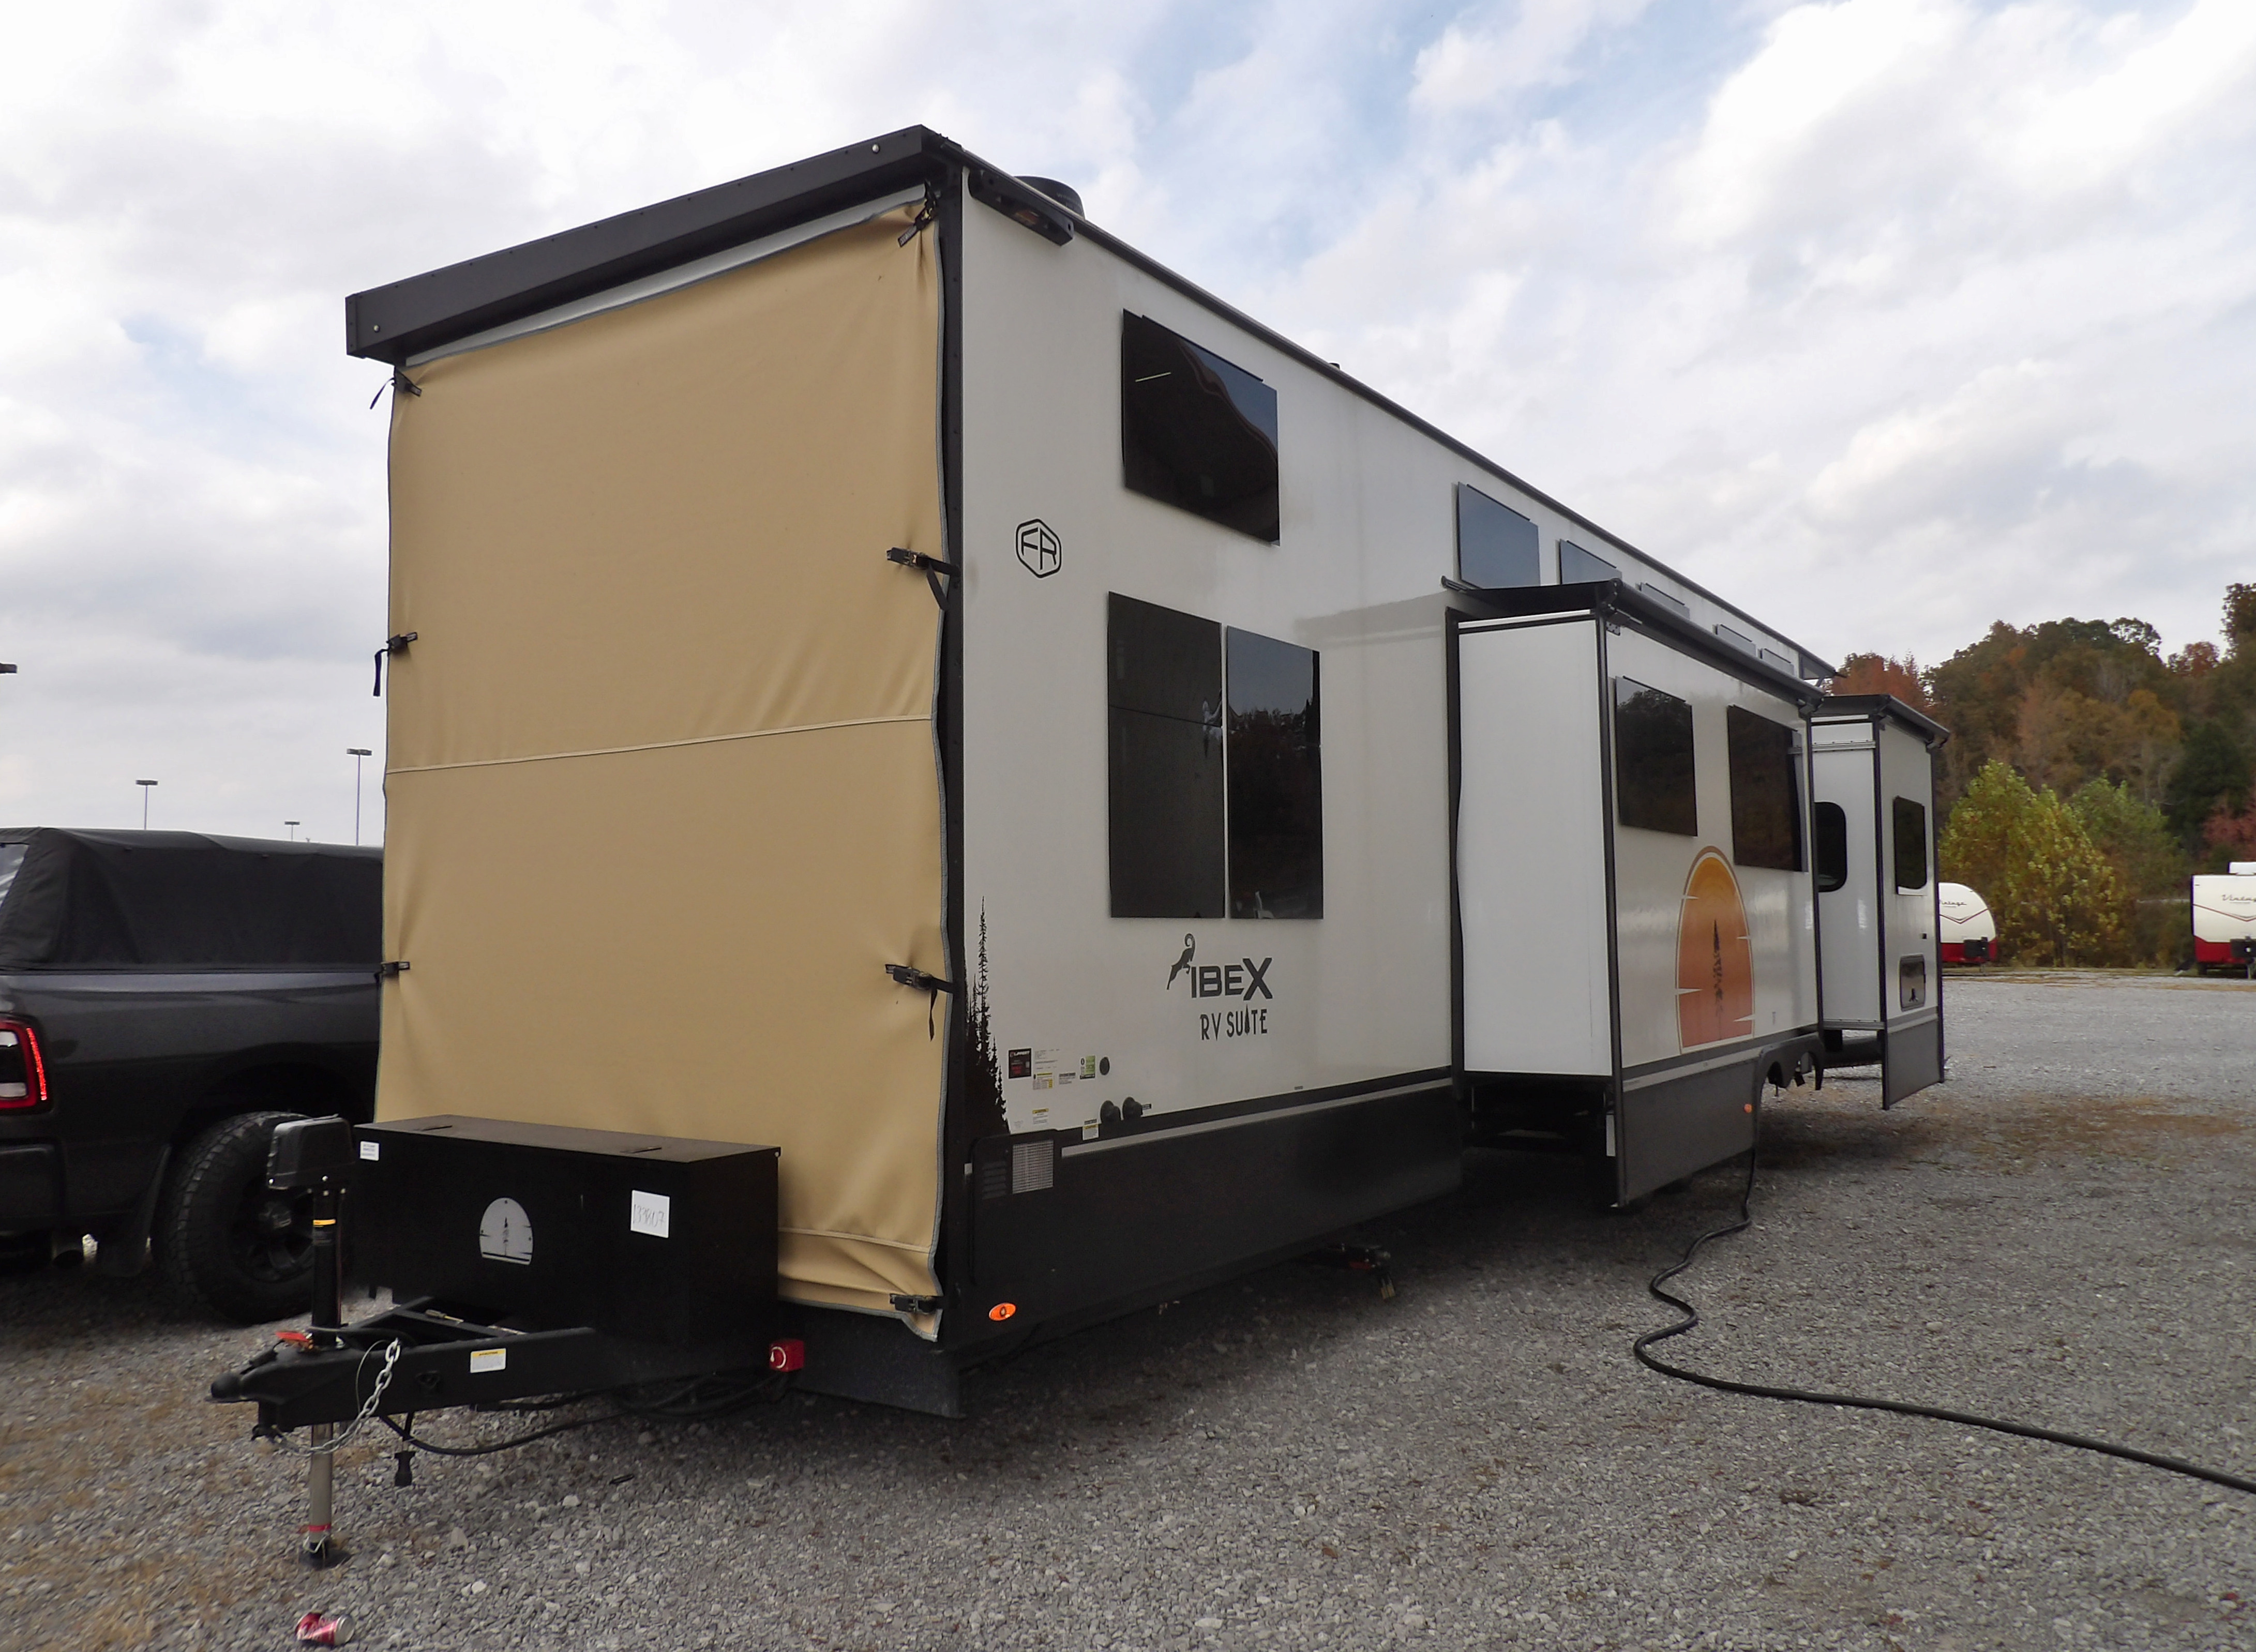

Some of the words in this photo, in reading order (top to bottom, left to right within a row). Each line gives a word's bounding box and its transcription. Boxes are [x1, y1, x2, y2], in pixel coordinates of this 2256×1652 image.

[1021, 526, 1057, 570] FR
[1199, 1012, 1222, 1041] RV
[1226, 1004, 1268, 1038] SUITE
